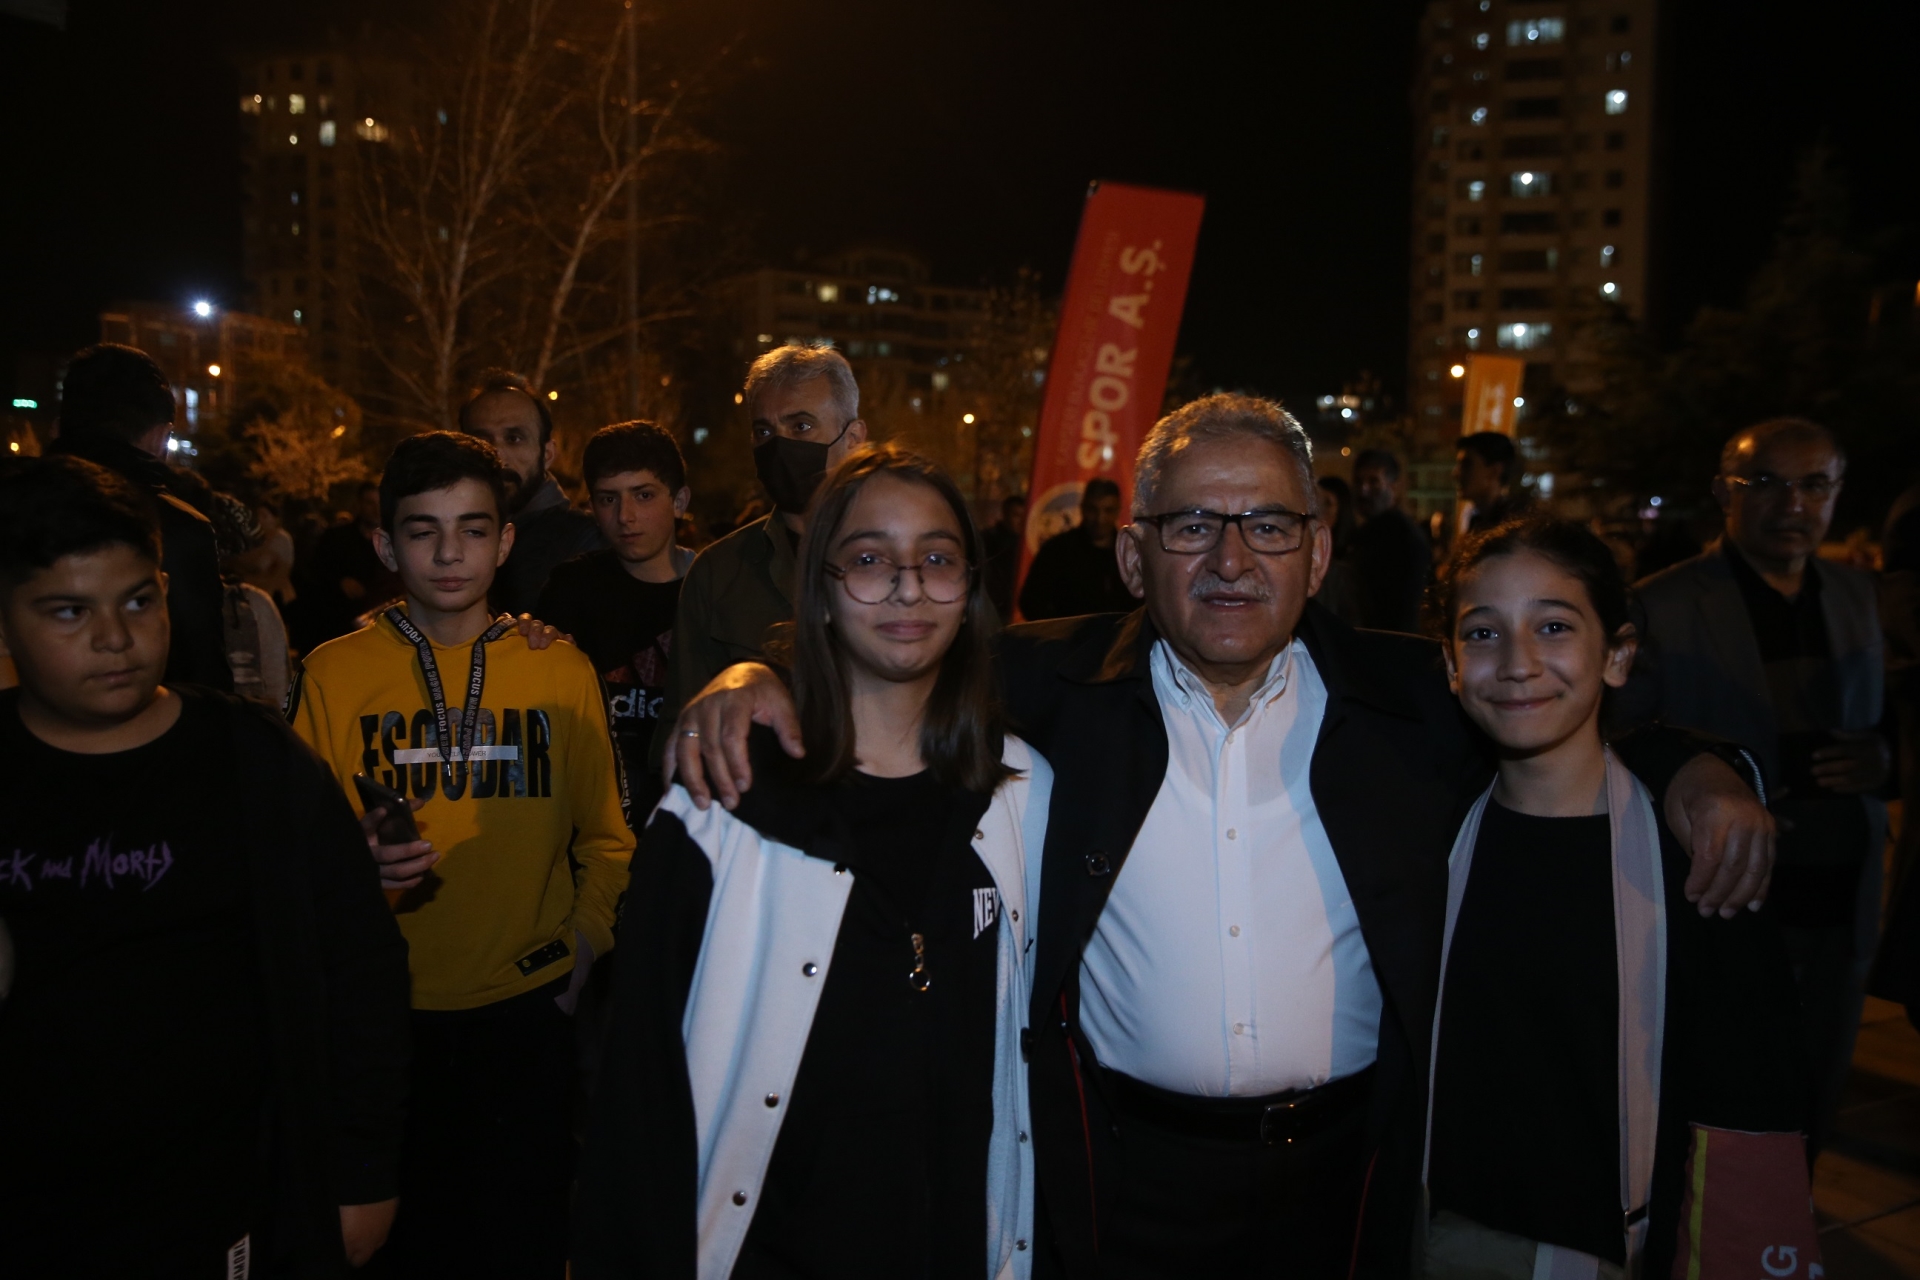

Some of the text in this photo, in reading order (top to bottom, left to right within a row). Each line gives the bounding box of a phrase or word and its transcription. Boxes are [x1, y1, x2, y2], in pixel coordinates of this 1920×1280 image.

[1076, 342, 1139, 472] SPOR
[398, 619, 422, 643] FOCUS
[470, 666, 483, 695] FOCUS
[436, 702, 447, 732] FOCUS
